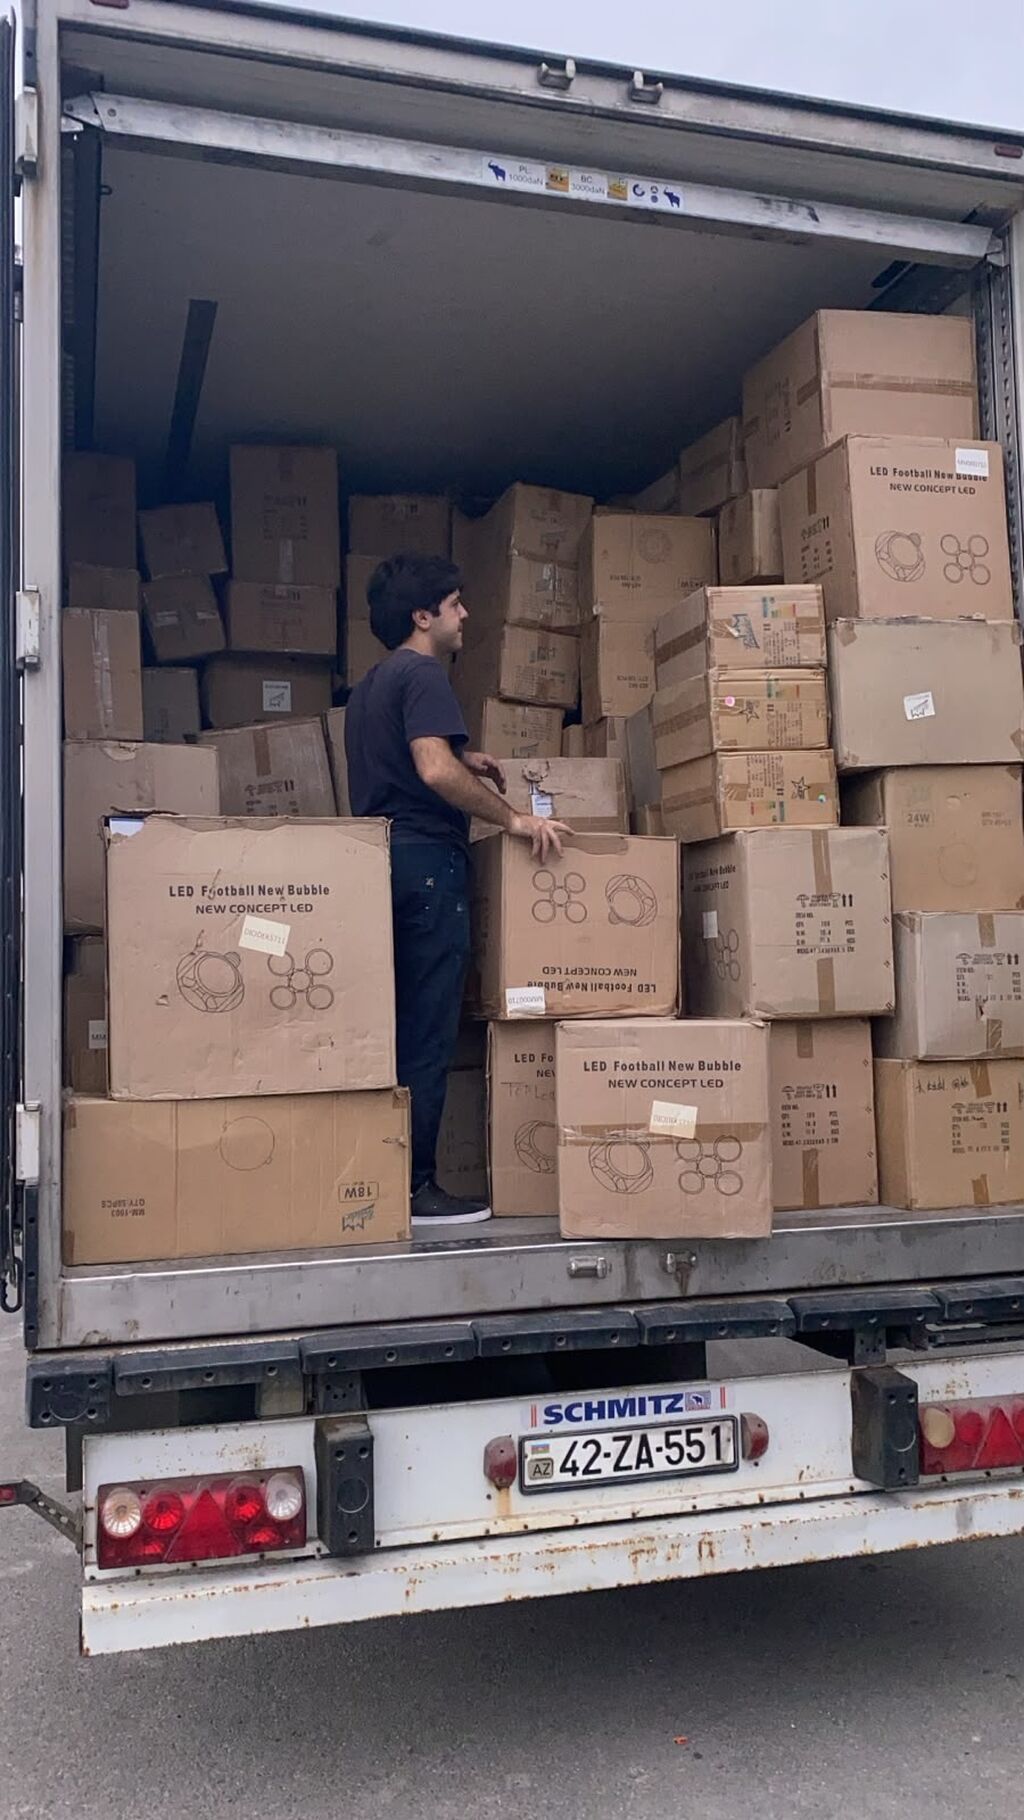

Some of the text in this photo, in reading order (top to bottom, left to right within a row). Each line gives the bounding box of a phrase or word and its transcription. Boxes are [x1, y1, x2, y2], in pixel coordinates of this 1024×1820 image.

[870, 466, 888, 476] LED
[893, 467, 932, 478] Football
[934, 470, 954, 480] New
[889, 483, 976, 495] NEW CONCEPT LED
[907, 813, 931, 823] 24W
[169, 884, 330, 897] LED Football New Bubble
[195, 903, 314, 914] NEW CONCEPT LED
[542, 966, 637, 977] NEW CONCEPT LED
[566, 981, 588, 992] New
[591, 982, 633, 993] Football
[638, 983, 657, 993] LED
[514, 1053, 536, 1063] LED
[583, 1060, 742, 1072] LED Football New Bubble
[608, 1079, 724, 1088] NEW CONCEPT LED
[344, 1186, 373, 1200] 18W
[543, 1393, 684, 1425] SCHMITZ
[559, 1425, 722, 1477] 42-ZA-551
[532, 1462, 551, 1477] AZ
